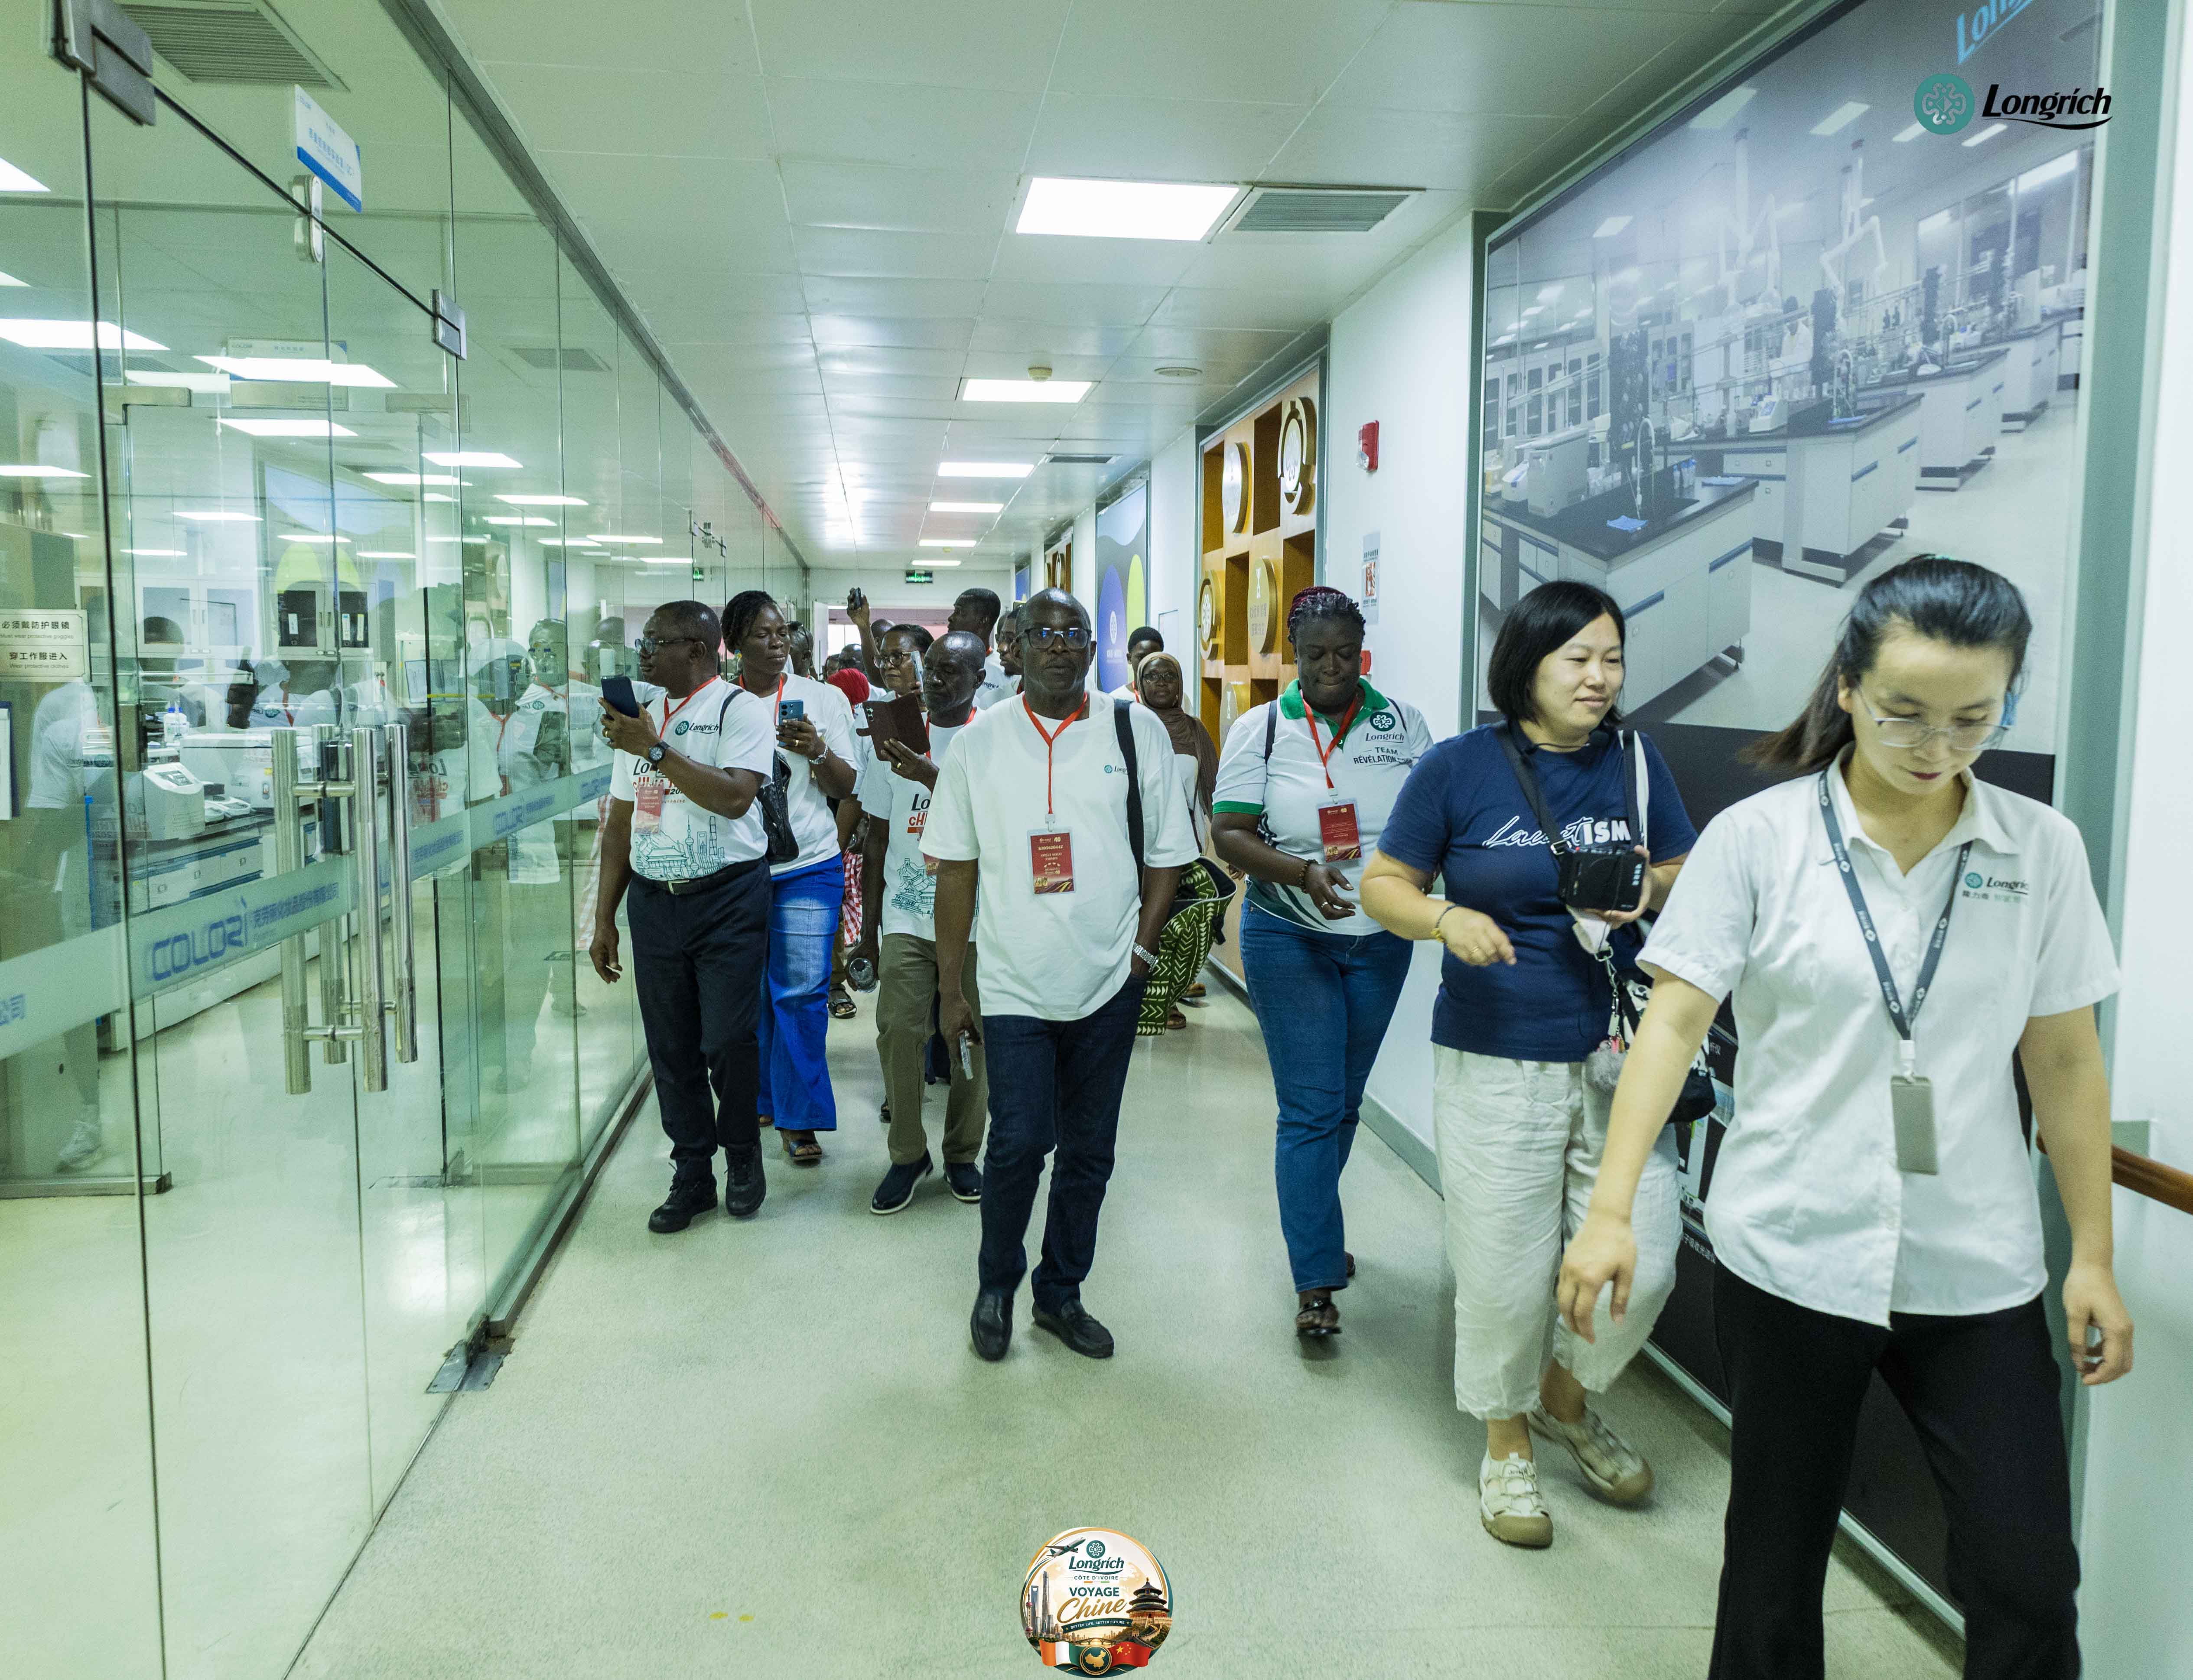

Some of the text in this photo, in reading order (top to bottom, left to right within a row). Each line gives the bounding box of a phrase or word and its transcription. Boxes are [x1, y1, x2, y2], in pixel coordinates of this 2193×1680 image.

[1956, 0, 2032, 65] Lon
[2, 620, 70, 629] 必须戴防护眼镜
[9, 652, 68, 660] 穿工作服进入
[1374, 747, 1398, 755] TEAM
